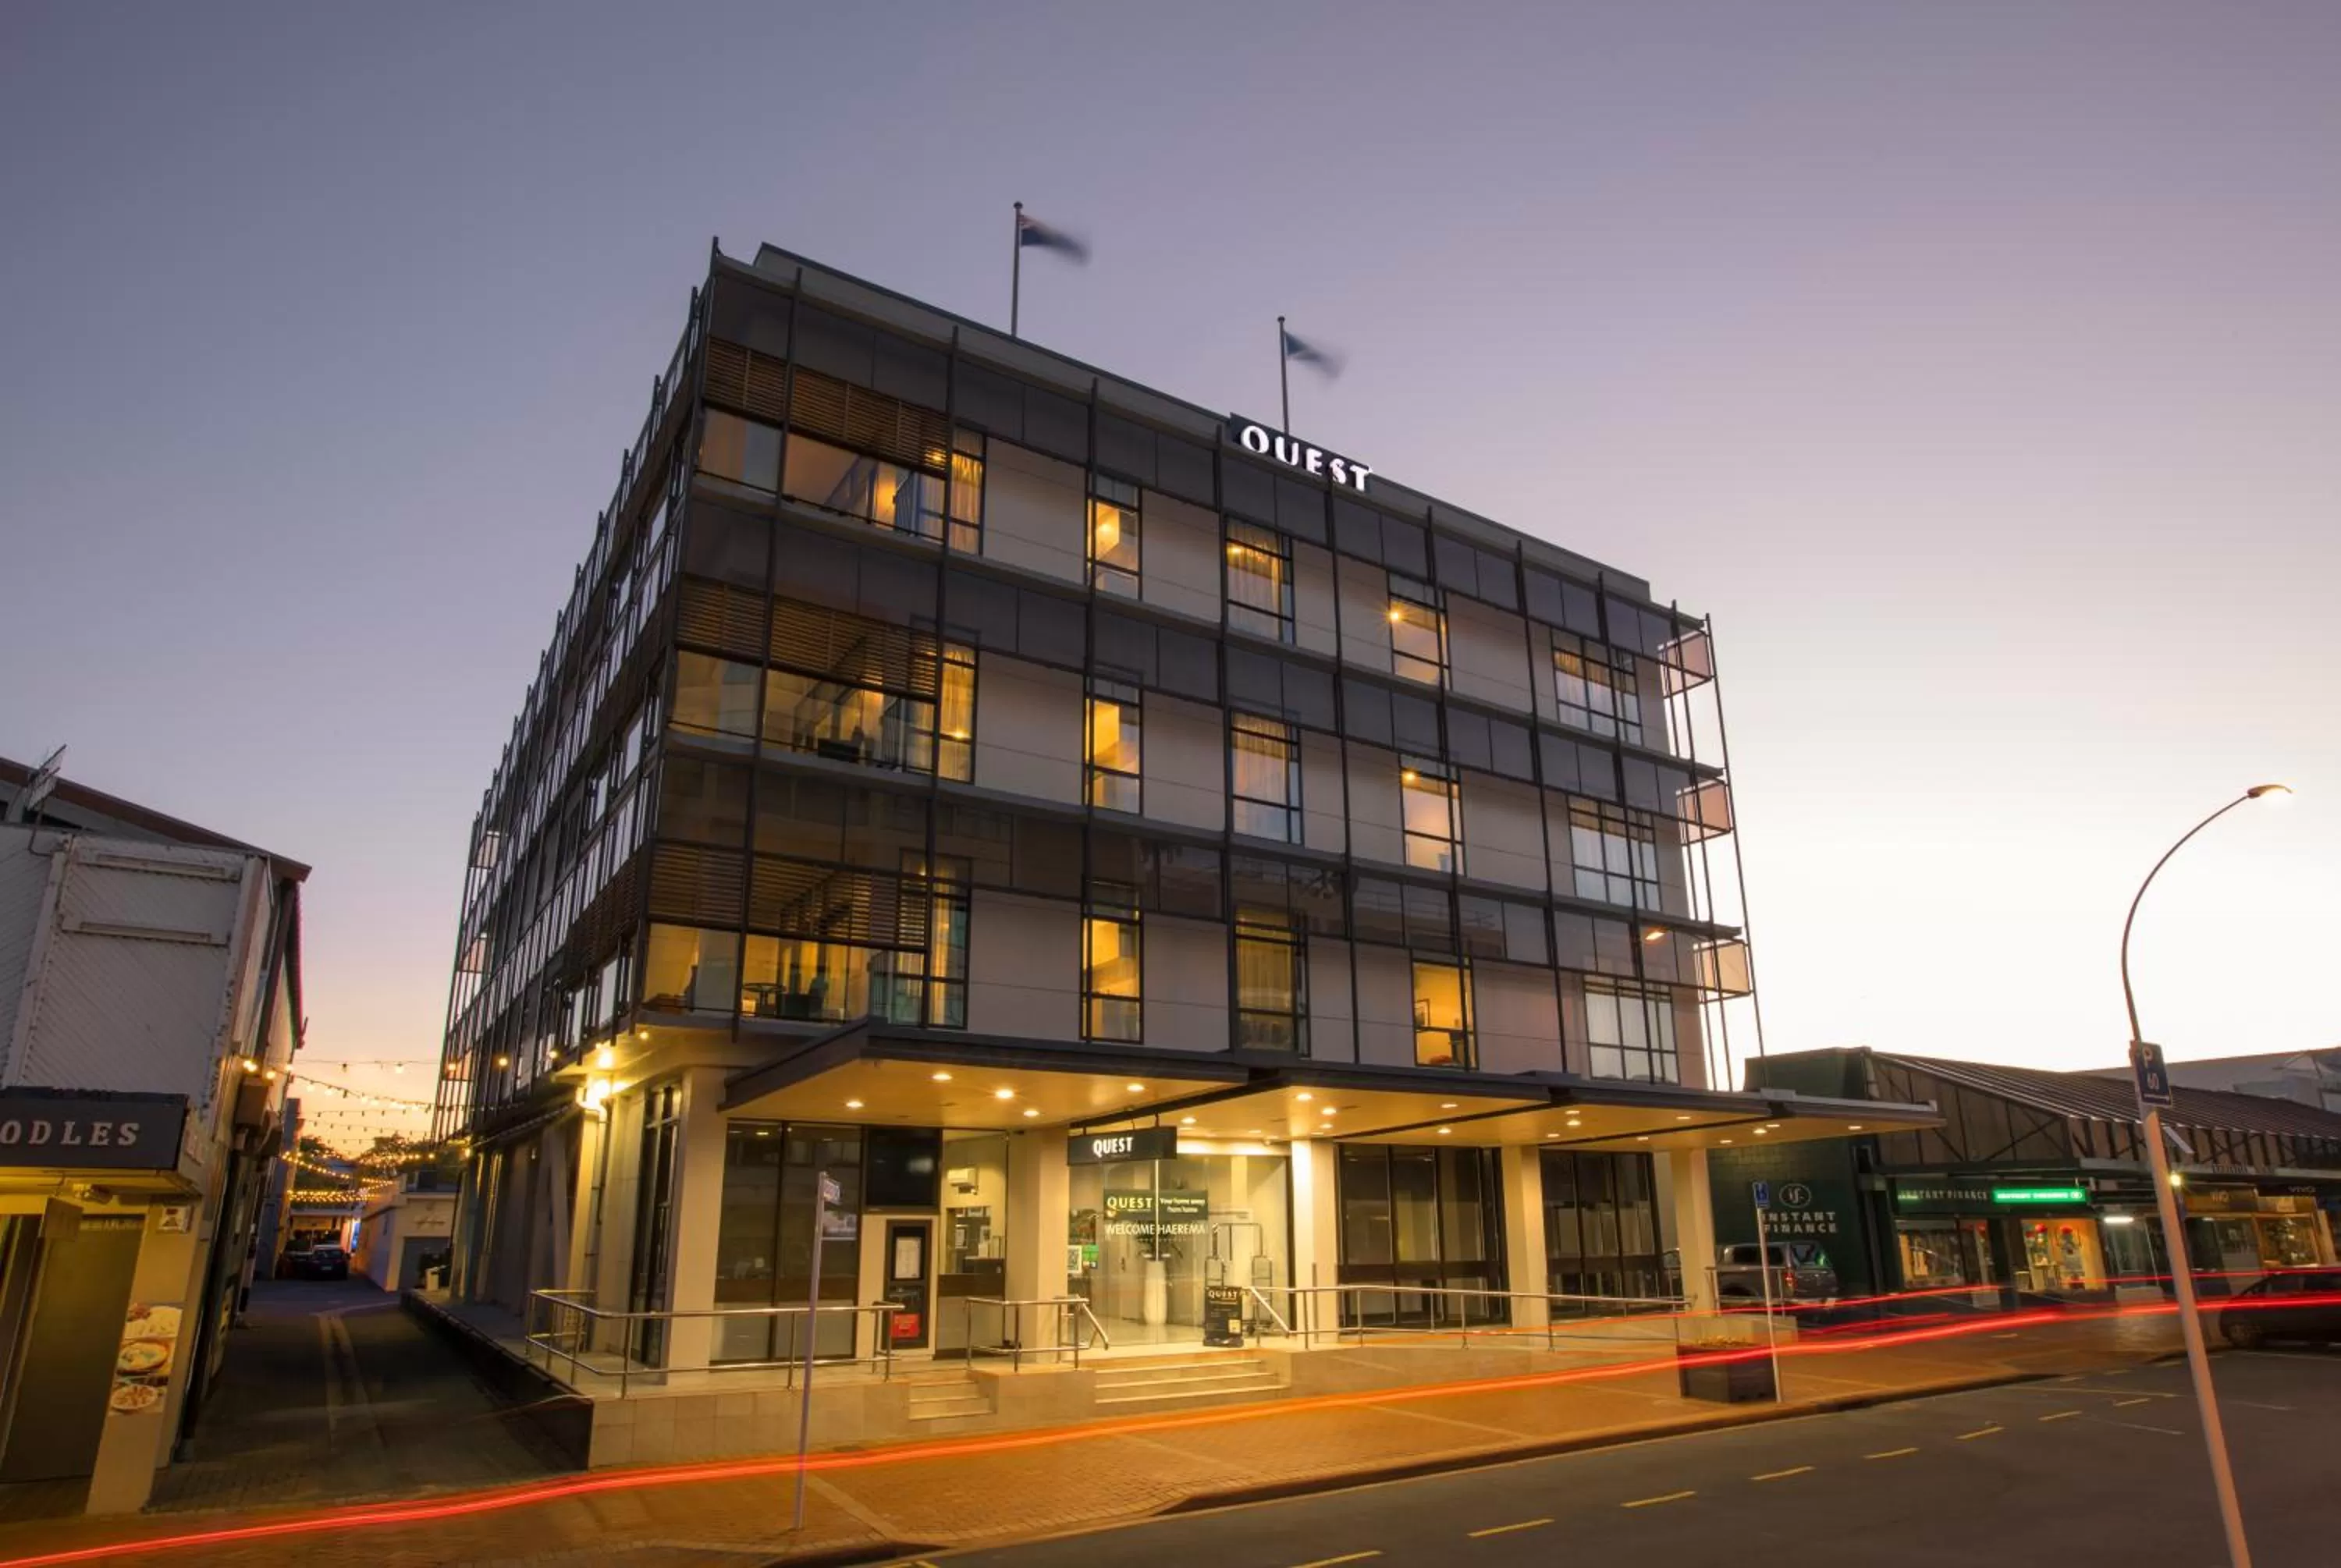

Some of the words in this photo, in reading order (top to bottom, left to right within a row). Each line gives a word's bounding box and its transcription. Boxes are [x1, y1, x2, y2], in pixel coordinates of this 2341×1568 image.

[1241, 425, 1373, 491] QUEST
[2142, 1046, 2153, 1070] P
[0, 1120, 140, 1146] ODLES
[1093, 1137, 1134, 1158] QUEST
[1107, 1196, 1153, 1210] QUEST
[1105, 1223, 1155, 1235] WELCOME
[1764, 1223, 1837, 1233] FINANCE
[1208, 1290, 1238, 1299] QUEST
